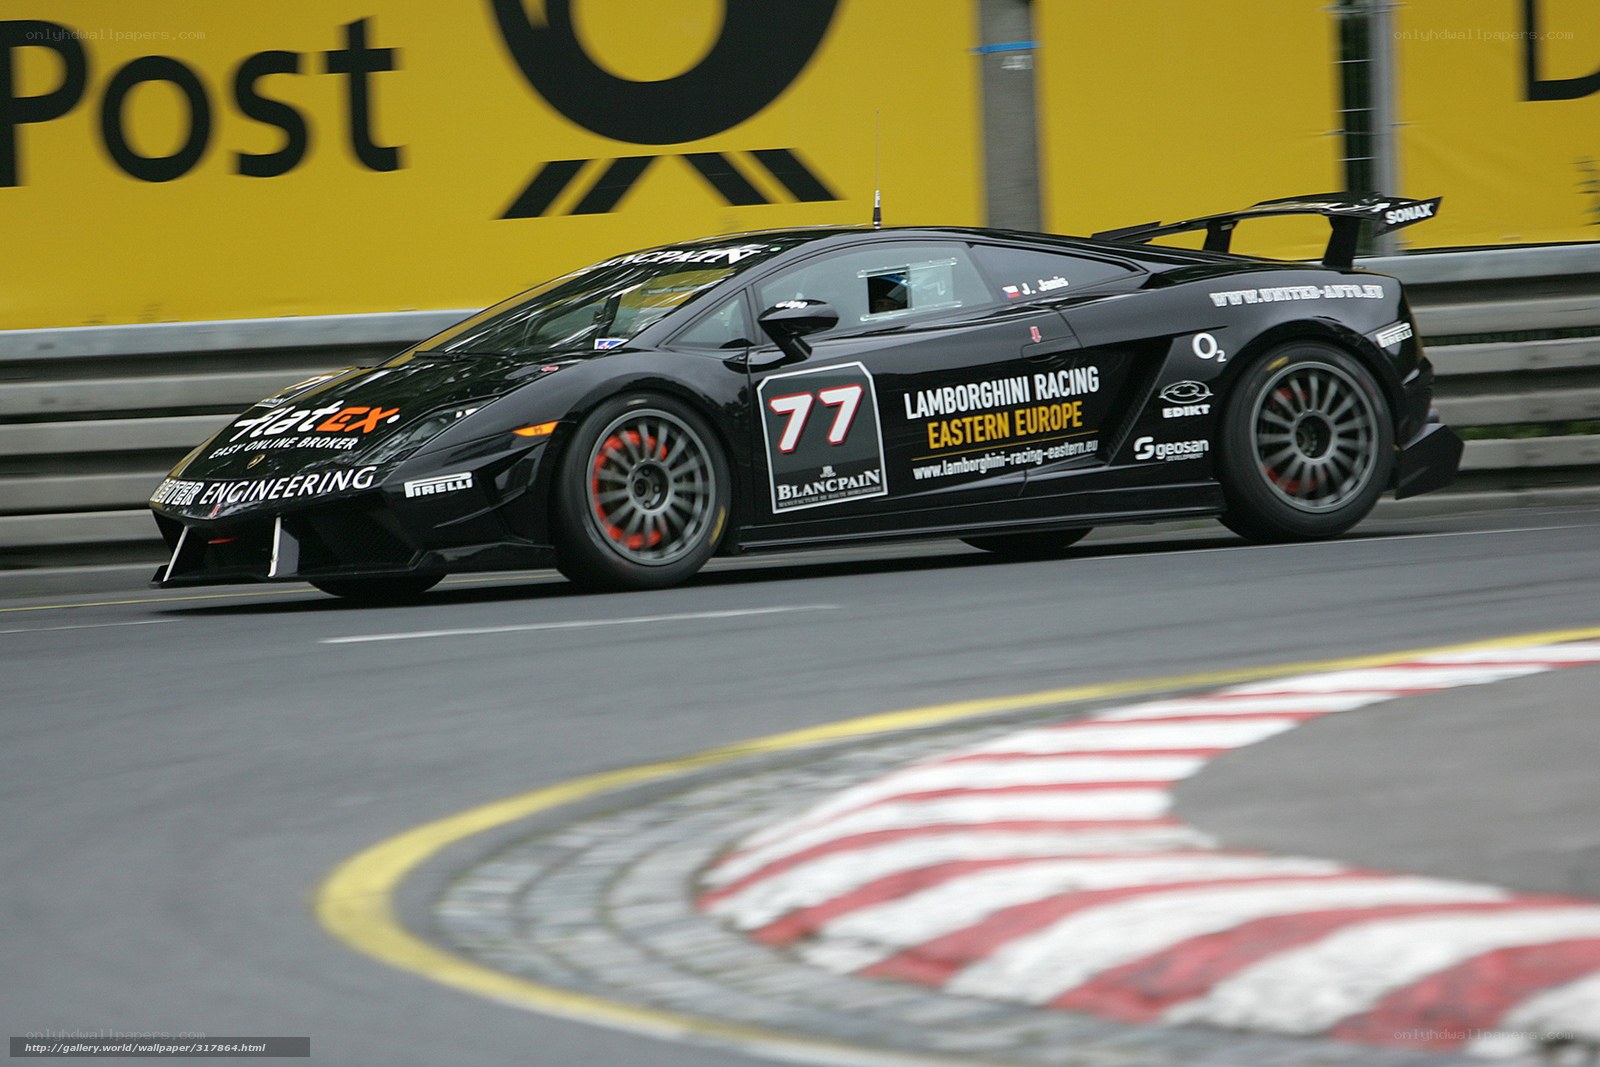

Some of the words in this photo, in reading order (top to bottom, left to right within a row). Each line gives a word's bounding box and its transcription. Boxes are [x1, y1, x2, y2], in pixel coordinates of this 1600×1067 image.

[0, 16, 408, 188] Post
[1385, 203, 1433, 225] SONAX
[903, 375, 1031, 420] LAMBORGHINI
[1033, 365, 1100, 401] RACING
[768, 383, 865, 454] 77
[927, 412, 1010, 450] EASTERN
[1014, 400, 1083, 437] EUROPE
[1162, 404, 1211, 419] EDIKT
[208, 445, 245, 460] EASY
[243, 438, 300, 452] ONLINE
[296, 436, 359, 451] BROKER
[912, 439, 1099, 480] www.lamborghini-racing-eastern.eu
[1155, 439, 1210, 460] geosan
[198, 465, 377, 505] ENGINEERING
[404, 471, 473, 498] PIRELLI
[776, 468, 881, 501] BLANCPAIN
